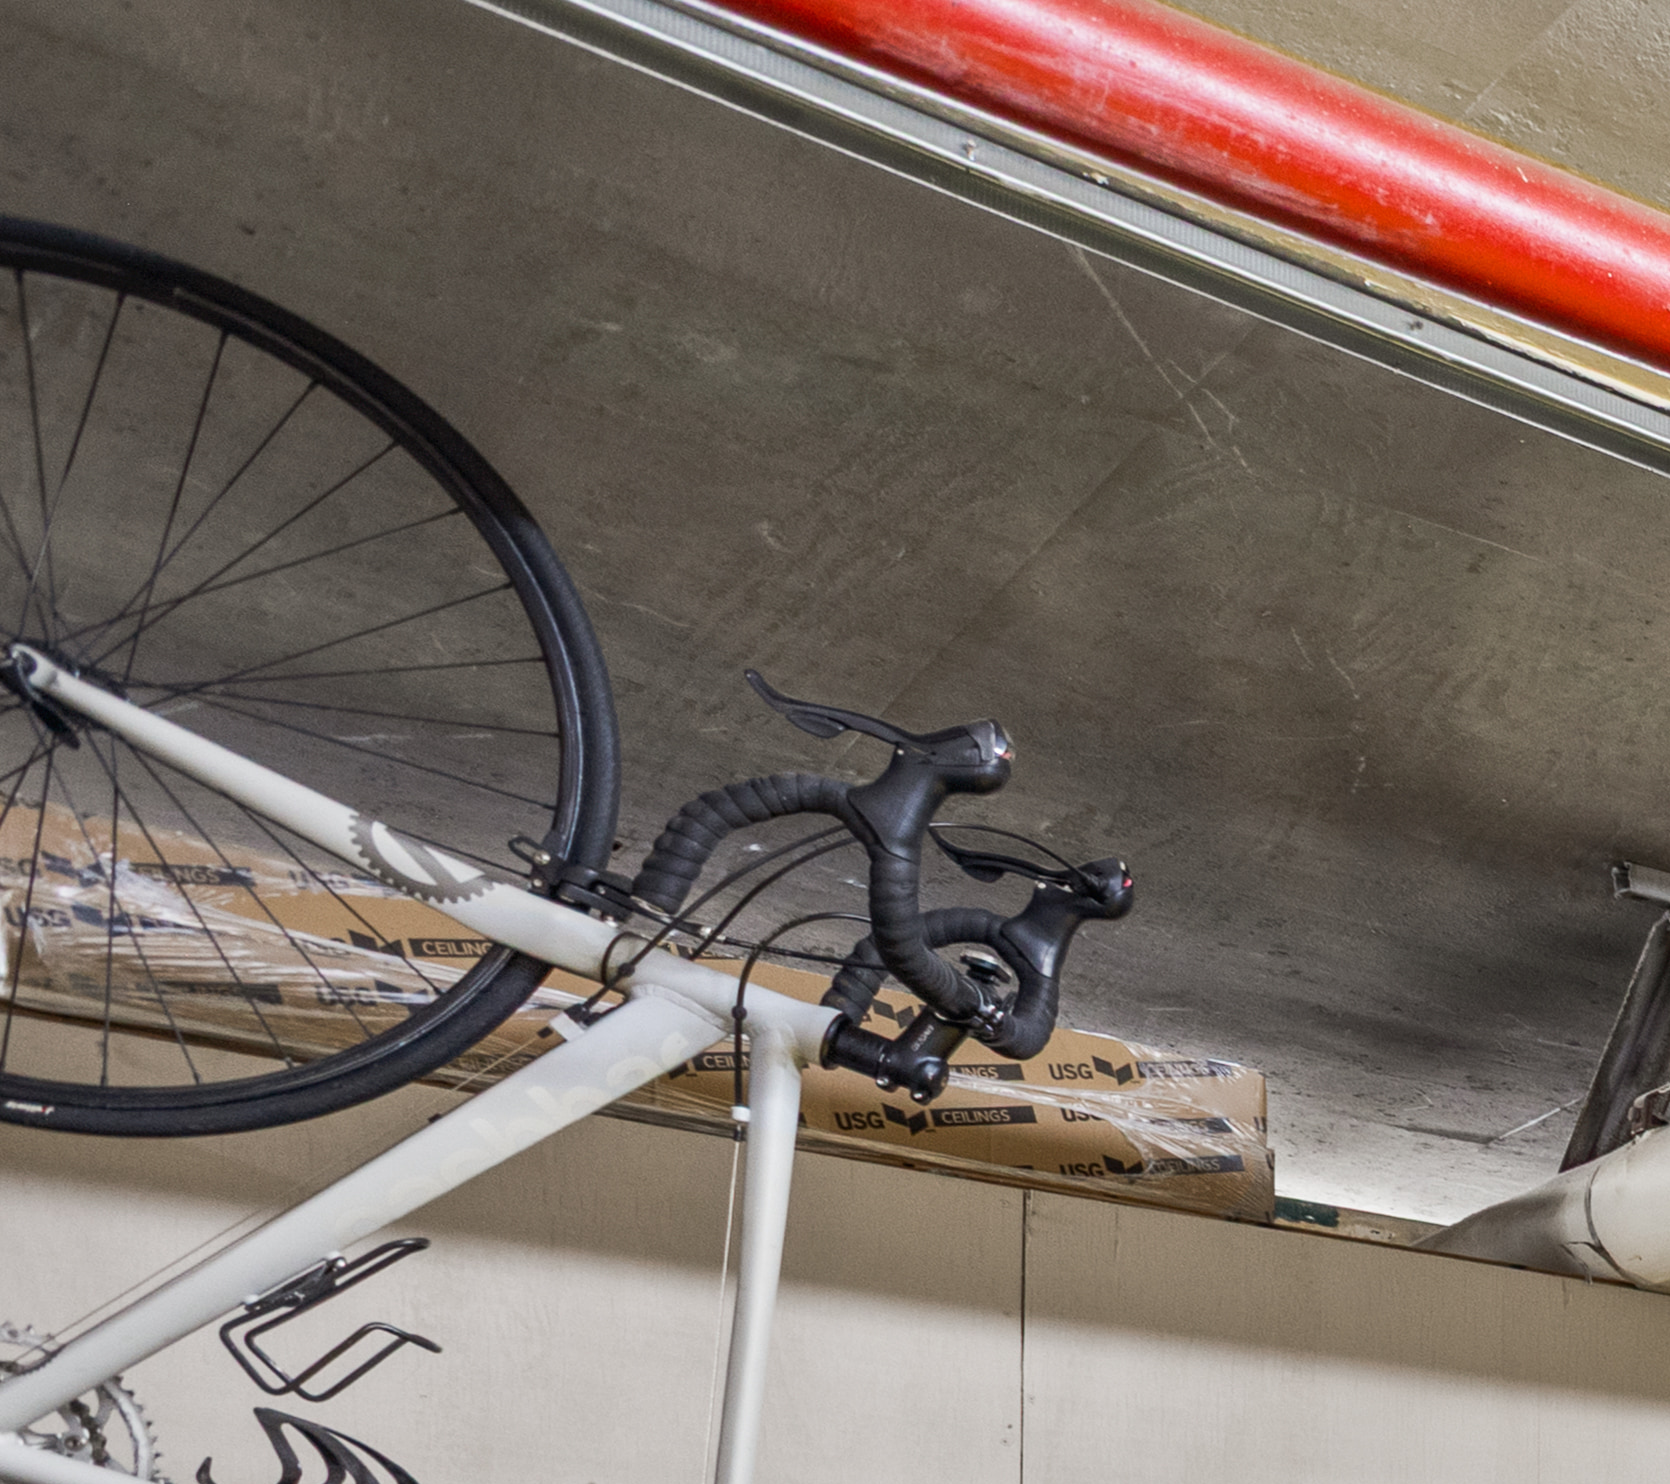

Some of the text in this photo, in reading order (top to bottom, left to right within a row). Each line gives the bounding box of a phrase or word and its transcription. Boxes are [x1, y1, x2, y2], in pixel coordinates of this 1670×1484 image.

[422, 939, 493, 957] CEILING
[1049, 1062, 1093, 1081] USG
[835, 1108, 1012, 1131] USG CEILINGS
